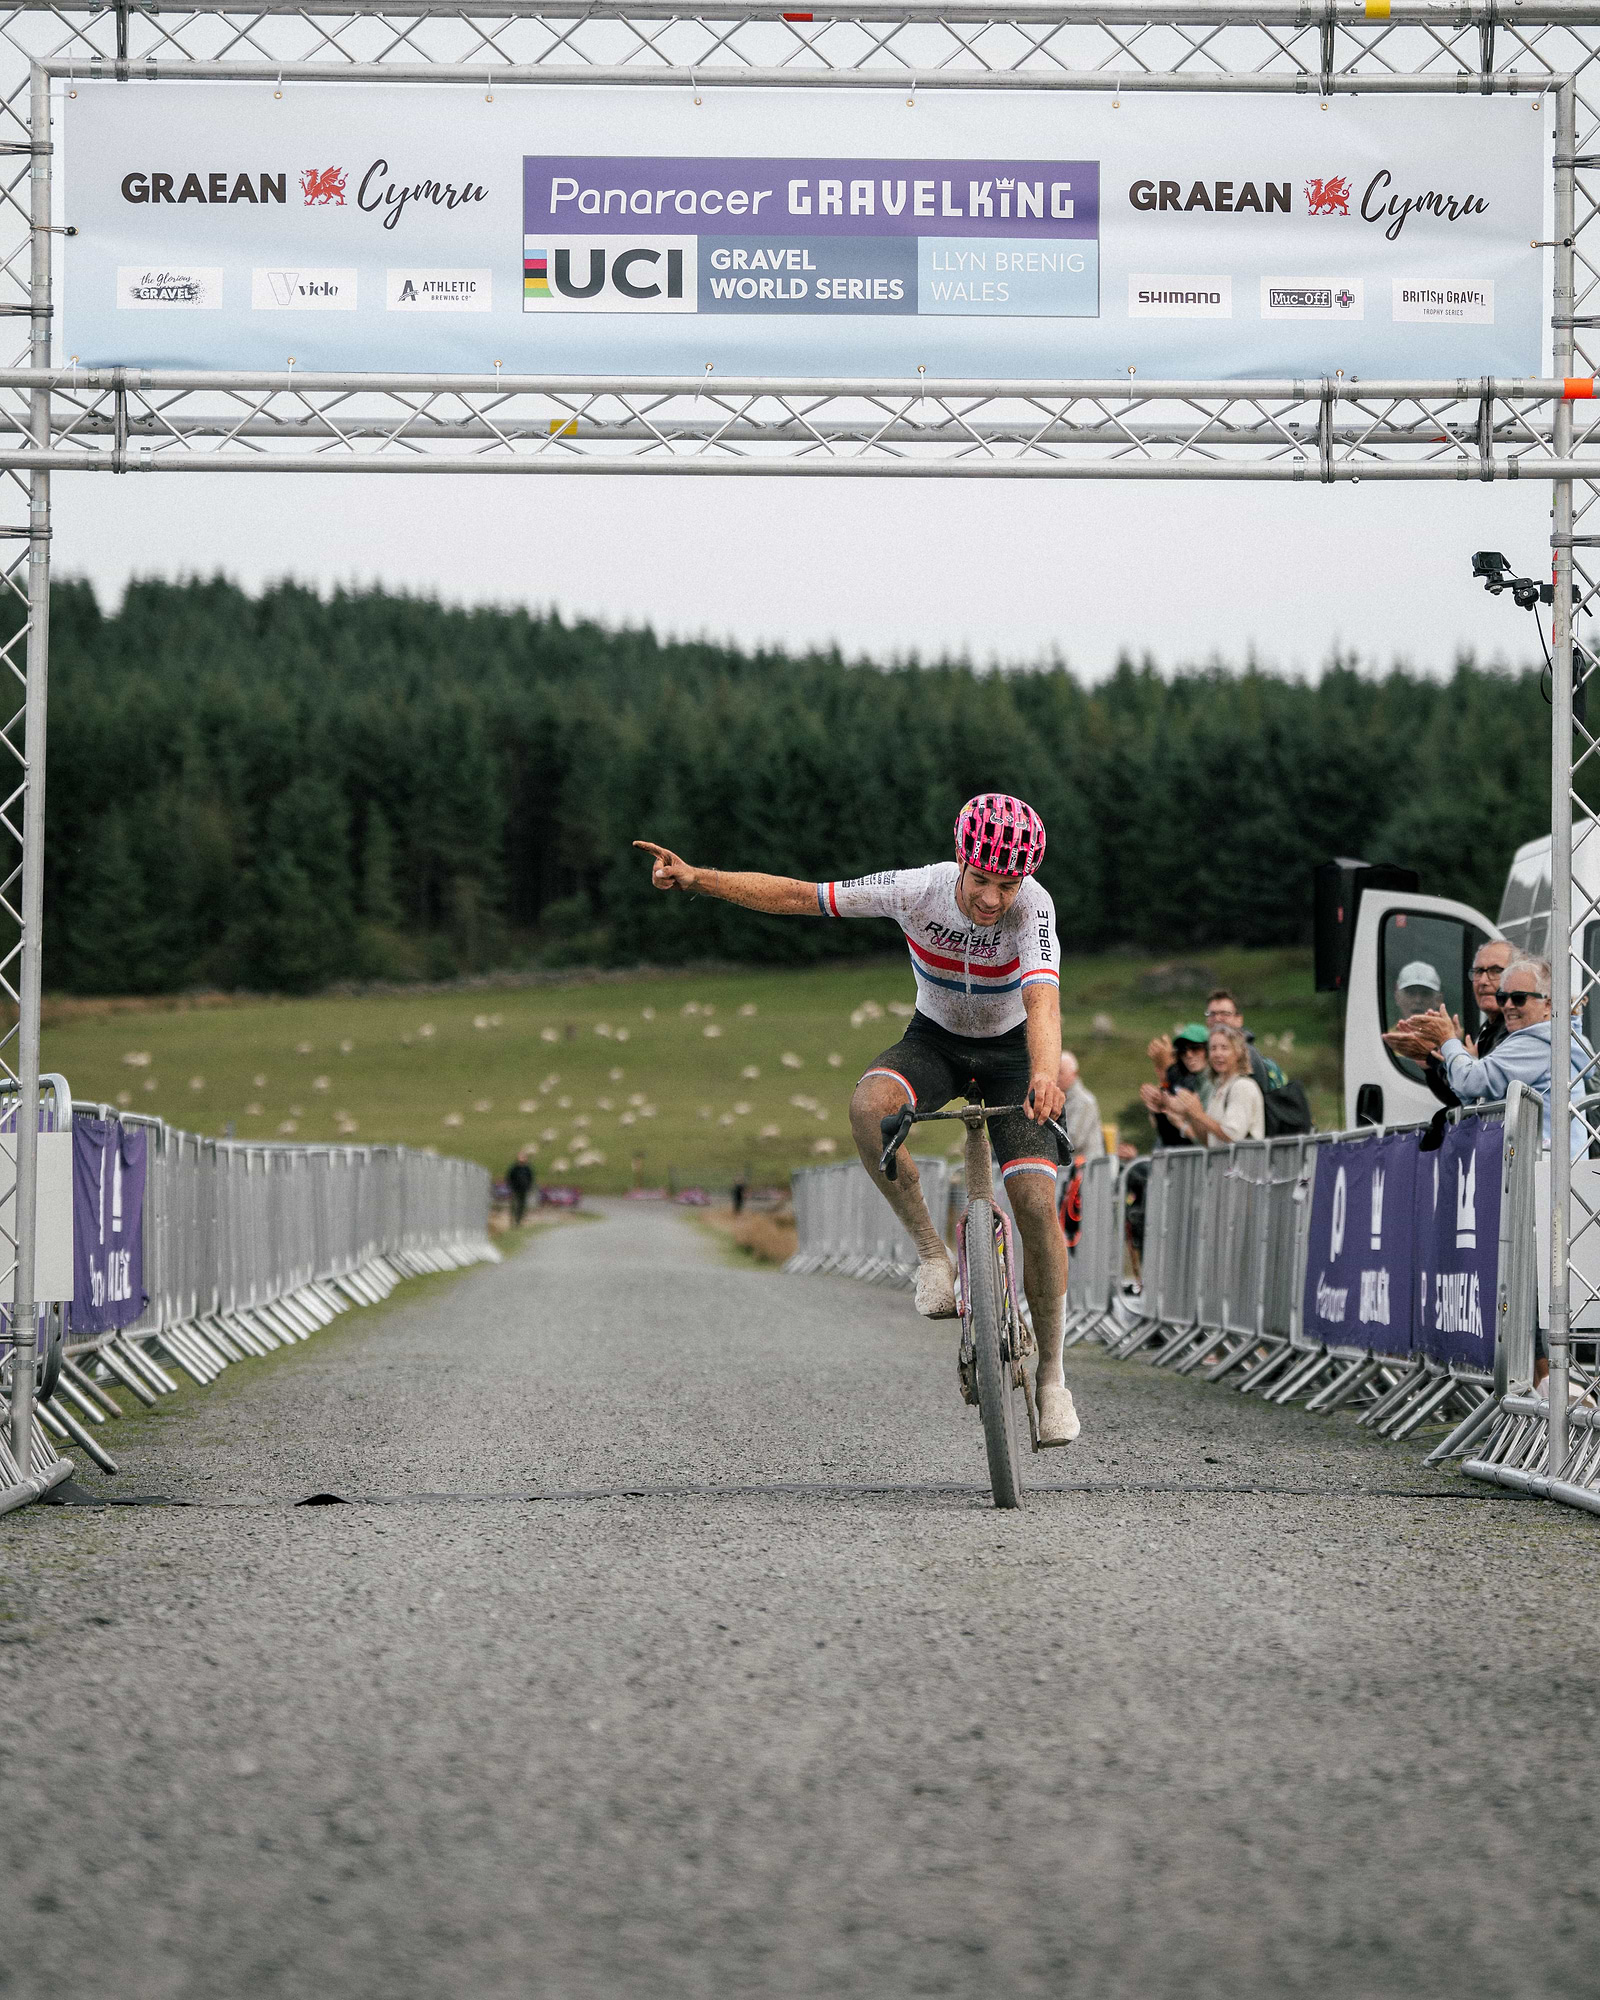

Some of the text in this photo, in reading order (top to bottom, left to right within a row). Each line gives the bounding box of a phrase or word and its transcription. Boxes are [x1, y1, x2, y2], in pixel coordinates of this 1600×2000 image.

[121, 158, 489, 230] GRAEAN Cymru
[551, 177, 1074, 219] Panaracer GRAVELKING
[1128, 169, 1490, 241] GRAEAN Cymru
[710, 248, 817, 270] GRAVEL
[932, 251, 1085, 273] LLYN BRENIG
[141, 272, 155, 286] the
[555, 248, 684, 299] UCI
[139, 288, 191, 299] GRAVEL
[422, 281, 476, 292] ATHLETIC
[710, 277, 904, 300] WORLD SERIES
[930, 281, 1010, 302] WALES
[1138, 291, 1221, 304] SHIMANO
[1402, 289, 1487, 306] BRITISH GRAVEL
[1273, 292, 1328, 305] Muc-Off
[1036, 910, 1052, 962] RIBBLE
